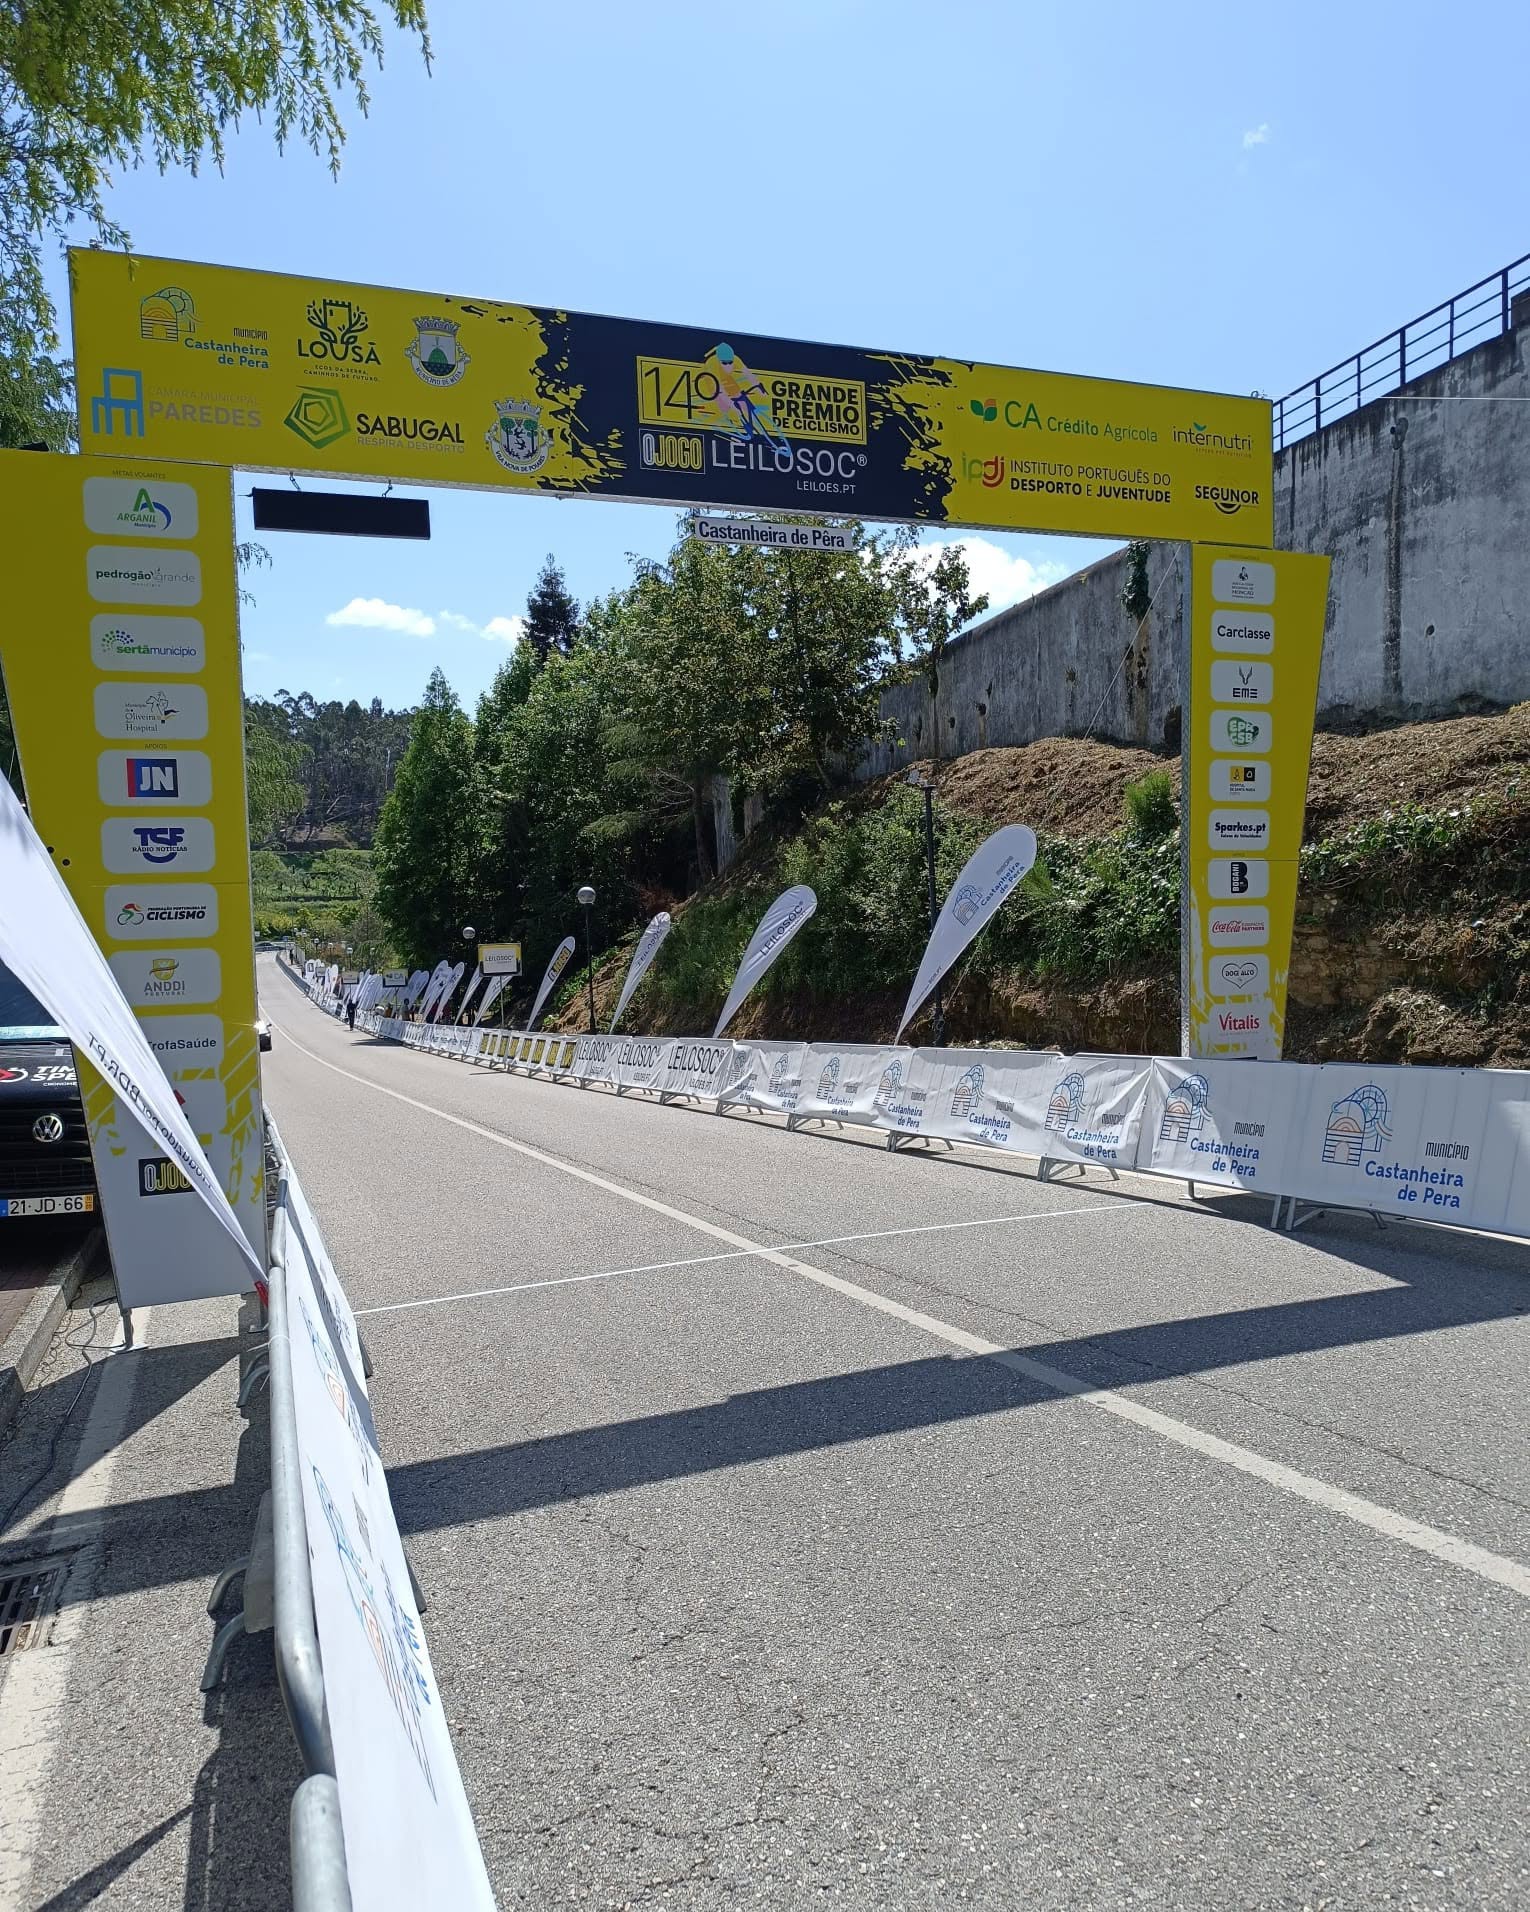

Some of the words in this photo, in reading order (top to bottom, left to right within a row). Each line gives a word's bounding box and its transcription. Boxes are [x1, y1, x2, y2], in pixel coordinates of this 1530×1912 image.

[184, 338, 269, 357] Castanheira
[298, 339, 381, 365] LOUSÃ
[217, 354, 234, 366] de
[239, 356, 269, 369] Pera
[771, 379, 859, 406] GRANDE
[150, 401, 262, 428] PAREDES
[1004, 400, 1042, 430] CA
[1047, 416, 1099, 436] Crédito
[1103, 422, 1158, 443] Agrícola
[356, 412, 465, 444] SABUGAL
[772, 416, 790, 428] DE
[792, 418, 860, 436] CICLISMO
[358, 436, 403, 449] RESPIRA
[407, 439, 465, 455] DESPORTO
[1173, 425, 1253, 450] internutri
[1010, 459, 1073, 477] INSTITUTO
[1078, 465, 1150, 485] PORTUGUÊS
[1153, 472, 1171, 486] DO
[796, 479, 857, 495] LEILOES.PT
[1010, 477, 1083, 496] DESPORTO
[1086, 483, 1092, 496] E
[1096, 485, 1171, 503] JUVENTUDE
[1195, 484, 1259, 505] SEGUNOR
[117, 512, 157, 523] ARGANIL
[698, 520, 787, 545] Castanheira
[790, 528, 809, 545] de
[812, 529, 845, 548] Pêra
[1217, 625, 1271, 640] Carclasse
[1232, 687, 1258, 698] EME
[126, 723, 158, 733] Hospital
[140, 766, 174, 791] JN
[133, 827, 185, 846] TSF
[1215, 821, 1266, 833] Sparkes.pt
[1232, 863, 1240, 892] BOGANI
[146, 910, 206, 921] CICLISMO
[144, 980, 185, 993] ANDDI
[1219, 1011, 1260, 1031] Vitalis
[888, 1102, 923, 1117] Castanheira
[897, 1116, 907, 1126] de
[907, 1117, 920, 1129] Pera
[969, 1112, 1011, 1130] Castanheira
[979, 1127, 990, 1138] de
[992, 1129, 1008, 1142] Pera
[1066, 1127, 1120, 1144] Castanheira
[1083, 1144, 1095, 1157] de
[1097, 1145, 1117, 1159] Pera
[1190, 1136, 1260, 1160] Castanheira
[1211, 1156, 1226, 1173] de
[1229, 1160, 1256, 1178] Pera
[1365, 1160, 1465, 1188] Castanheira
[1397, 1186, 1418, 1203] de
[1422, 1189, 1461, 1209] Pera
